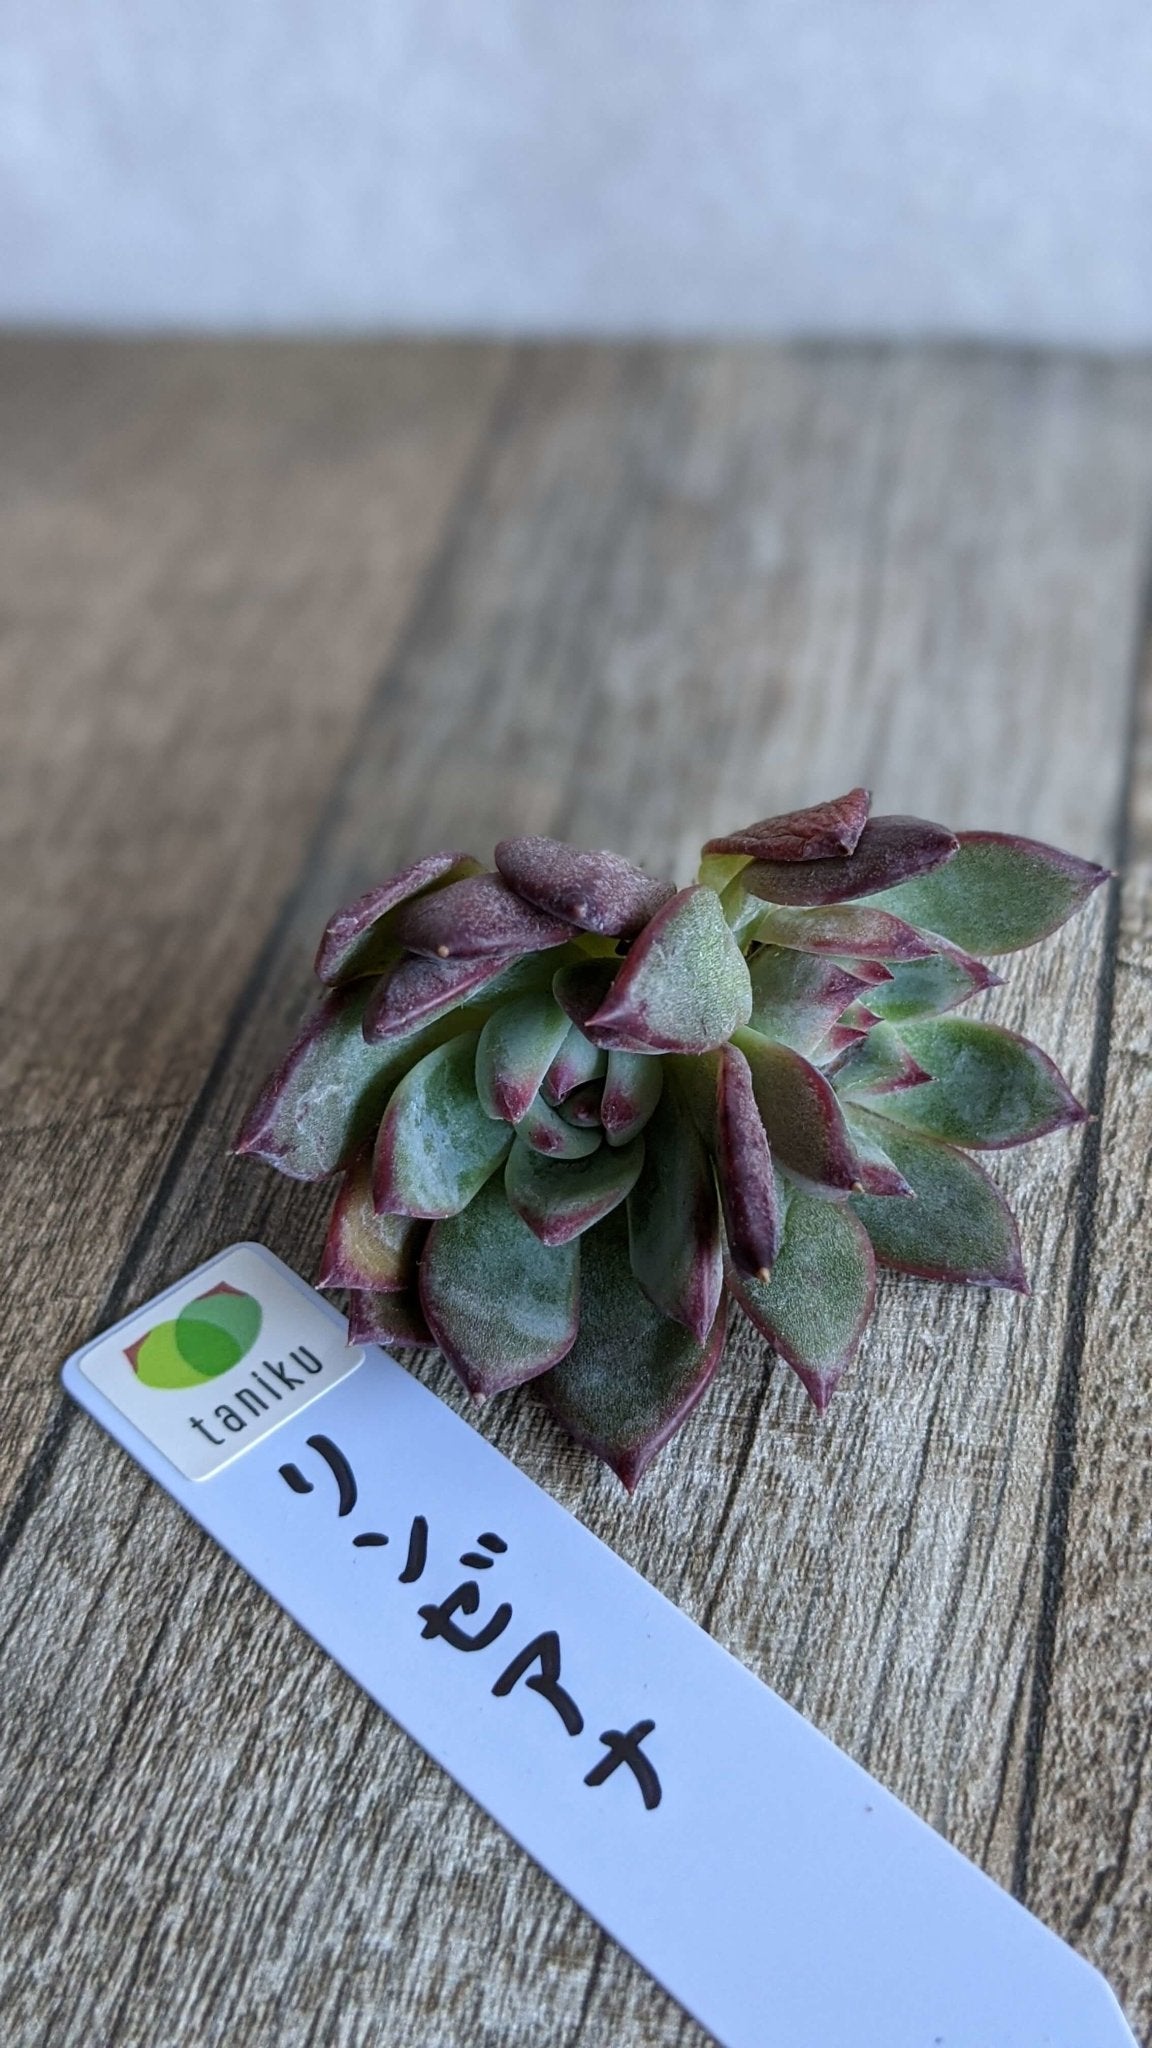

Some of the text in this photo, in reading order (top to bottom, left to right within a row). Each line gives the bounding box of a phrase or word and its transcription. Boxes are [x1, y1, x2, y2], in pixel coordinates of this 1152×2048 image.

[189, 1345, 323, 1445] taniku
[278, 1434, 662, 1810] リンゼアナ
